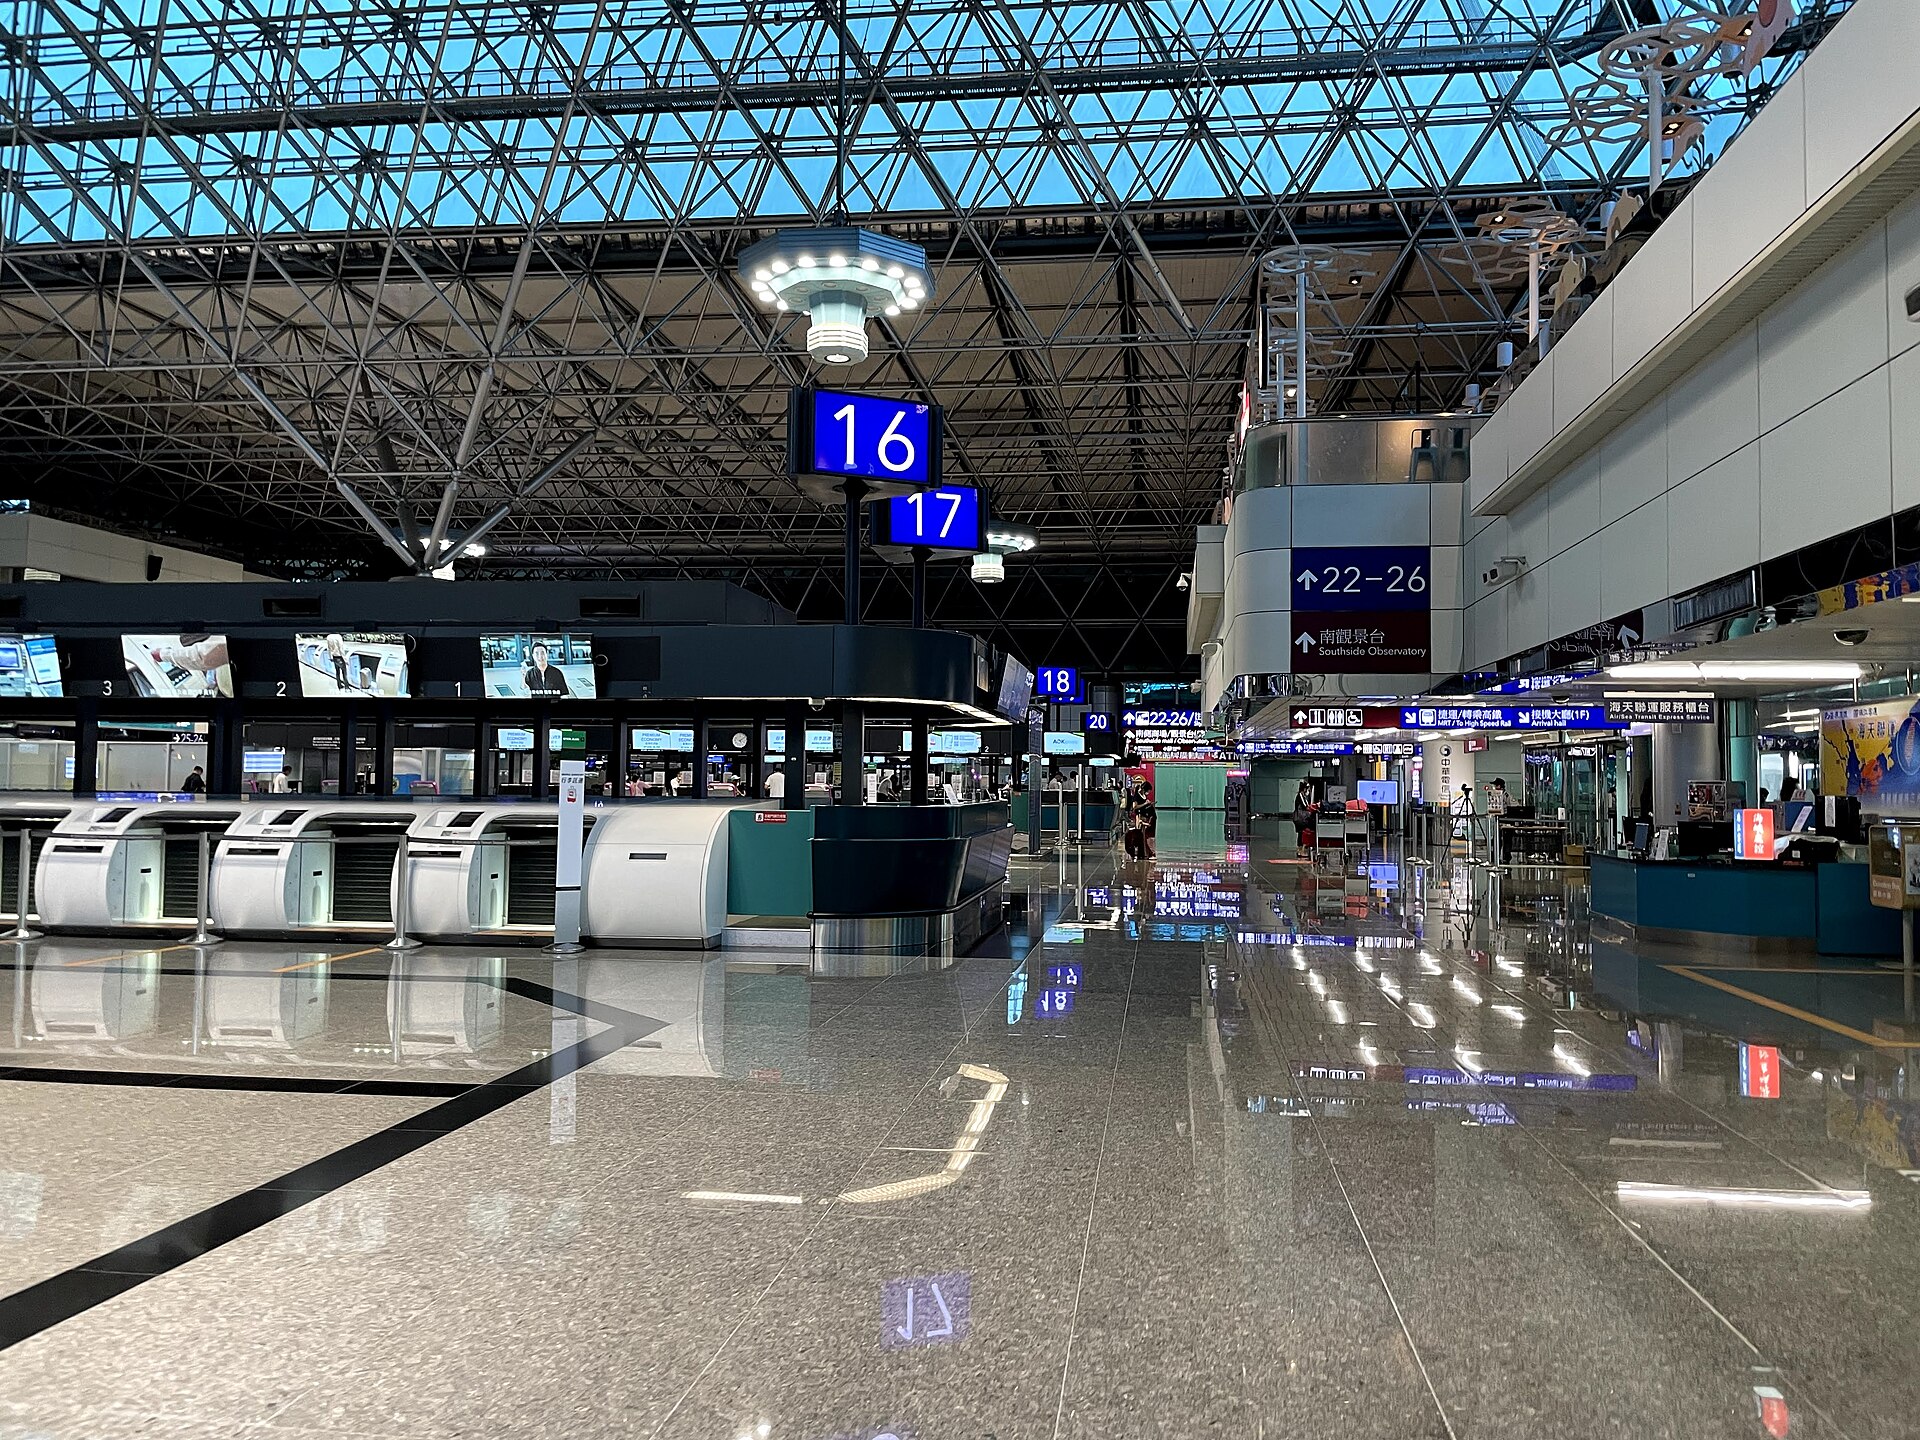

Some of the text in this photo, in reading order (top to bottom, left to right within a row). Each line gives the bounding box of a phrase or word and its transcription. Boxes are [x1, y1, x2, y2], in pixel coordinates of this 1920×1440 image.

[833, 404, 915, 472] 16
[906, 492, 962, 538] 17
[1319, 628, 1385, 645] 南觀景台
[1318, 646, 1427, 658] Southside Observatory
[102, 680, 112, 696] 3
[276, 681, 287, 697] 2
[454, 681, 462, 697] 1
[1043, 669, 1070, 693] 18
[1089, 714, 1107, 730] 20
[1465, 720, 1480, 728] High
[1480, 720, 1497, 728] Speed
[1659, 713, 1684, 721] Express
[1686, 713, 1710, 721] Service
[984, 745, 990, 753] 2
